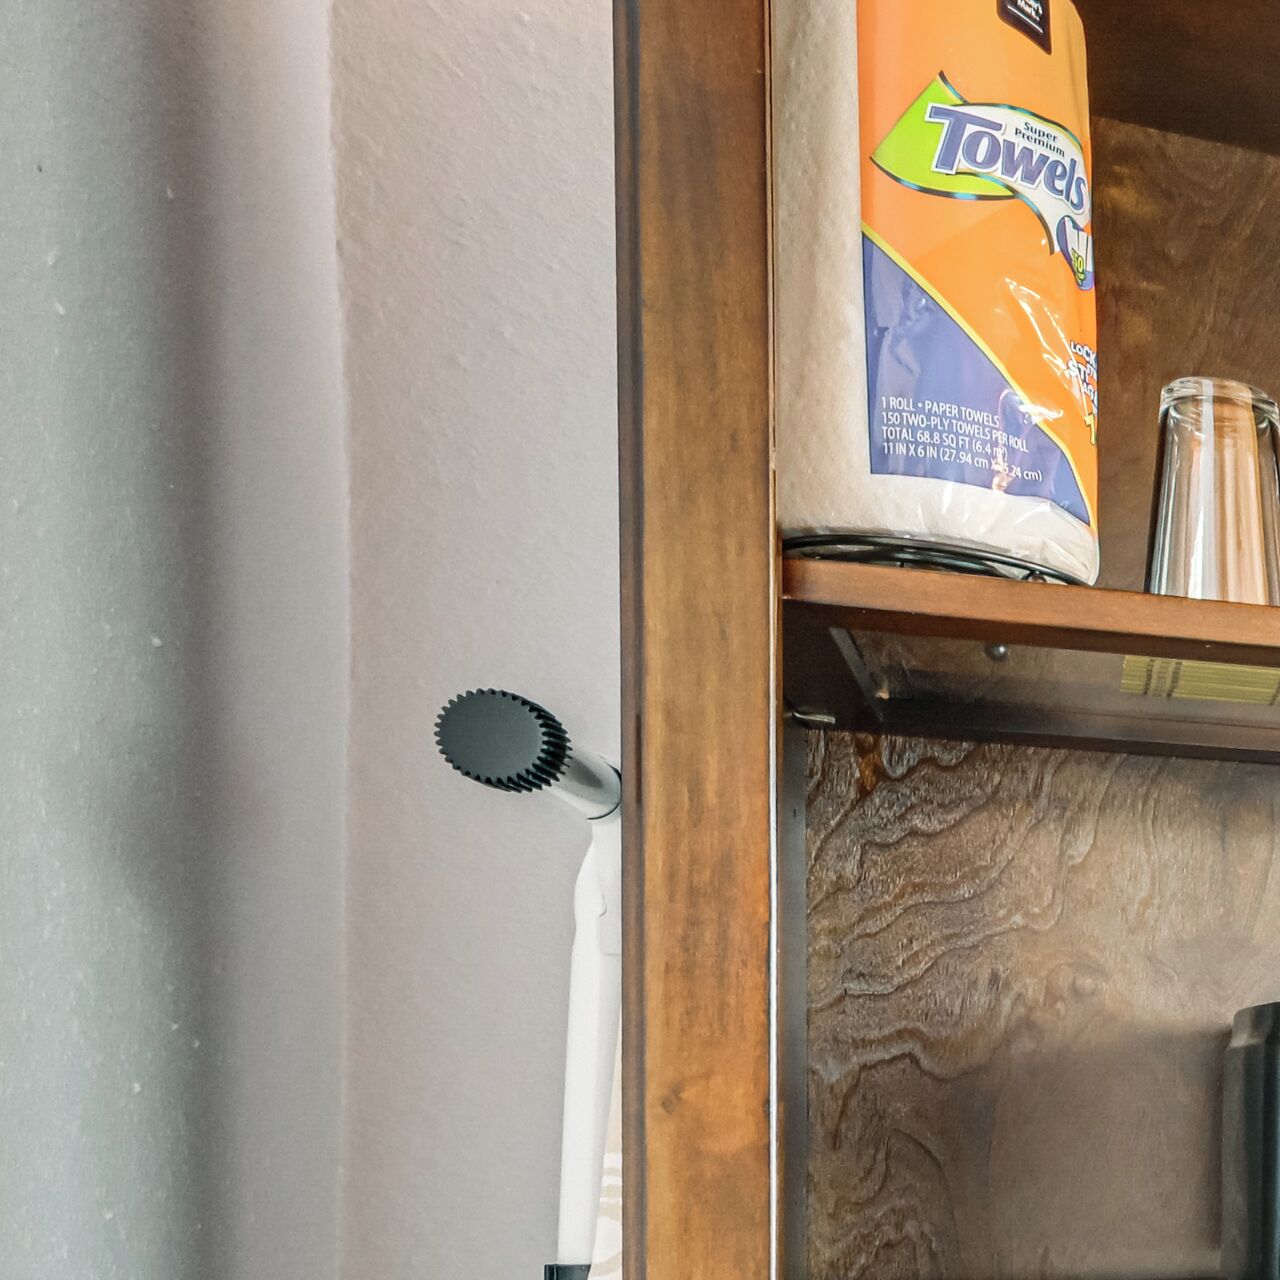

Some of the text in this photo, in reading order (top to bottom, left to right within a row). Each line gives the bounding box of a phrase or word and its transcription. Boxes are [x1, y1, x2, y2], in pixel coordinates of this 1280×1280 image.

[1014, 127, 1065, 157] Premium
[1023, 121, 1058, 142] Super
[926, 103, 1087, 213] Towels
[882, 396, 1000, 428] 1 ROLL PAPER TOWELS
[881, 426, 915, 441] TOTAL
[917, 430, 940, 445] 68.8
[943, 433, 957, 449] SQ
[958, 435, 970, 450] FT
[882, 412, 1029, 453] 150 TWO-PLY TOWELS PER ROLL
[883, 442, 894, 455] 11
[895, 443, 907, 456] IN
[909, 444, 916, 457] X
[917, 445, 925, 458] 6
[926, 446, 938, 459] IN
[940, 447, 973, 466] (27.94
[974, 456, 989, 469] cm
[1023, 469, 1043, 482] cm)
